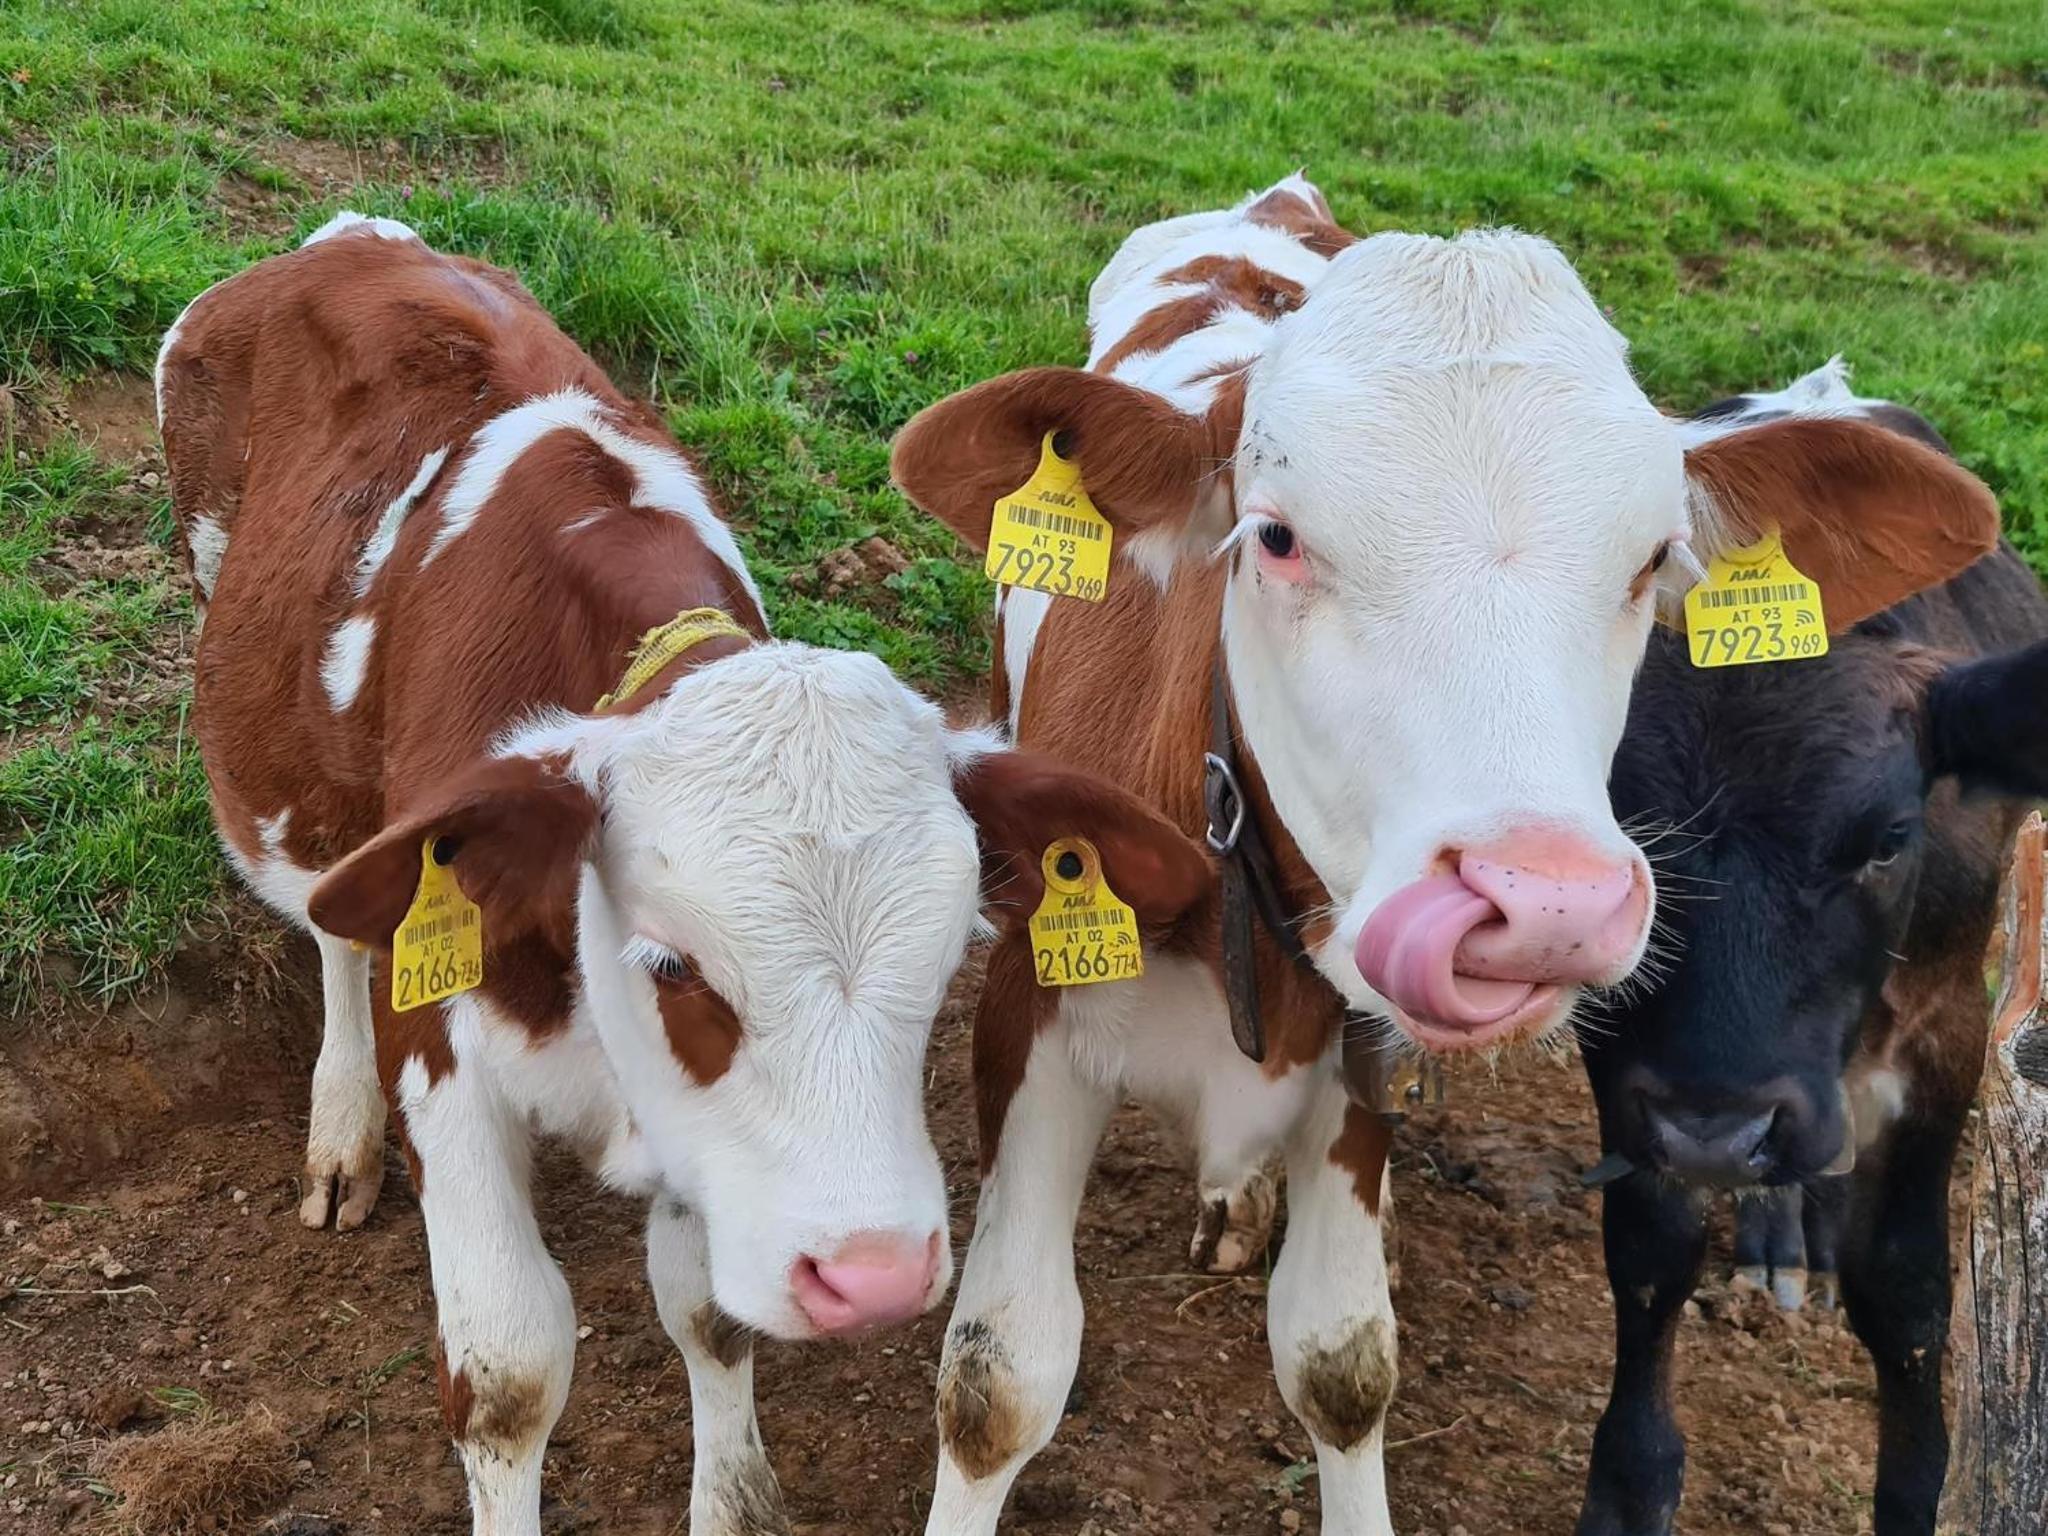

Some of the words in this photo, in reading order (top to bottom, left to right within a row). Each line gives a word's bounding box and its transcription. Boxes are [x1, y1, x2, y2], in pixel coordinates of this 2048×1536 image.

[1032, 534, 1050, 548] AT
[1059, 539, 1076, 555] 93
[993, 543, 1074, 594] 7923
[1076, 576, 1103, 600] 969
[1732, 610, 1751, 624] AT
[1761, 607, 1782, 620] 93
[1697, 623, 1786, 664] 7923
[1791, 633, 1821, 655] 969
[421, 942, 435, 958] AT
[440, 935, 454, 951] 02
[1066, 932, 1080, 944] AT
[1087, 929, 1104, 942] 02
[1038, 943, 1110, 983] 2166
[399, 951, 457, 1007] 2166
